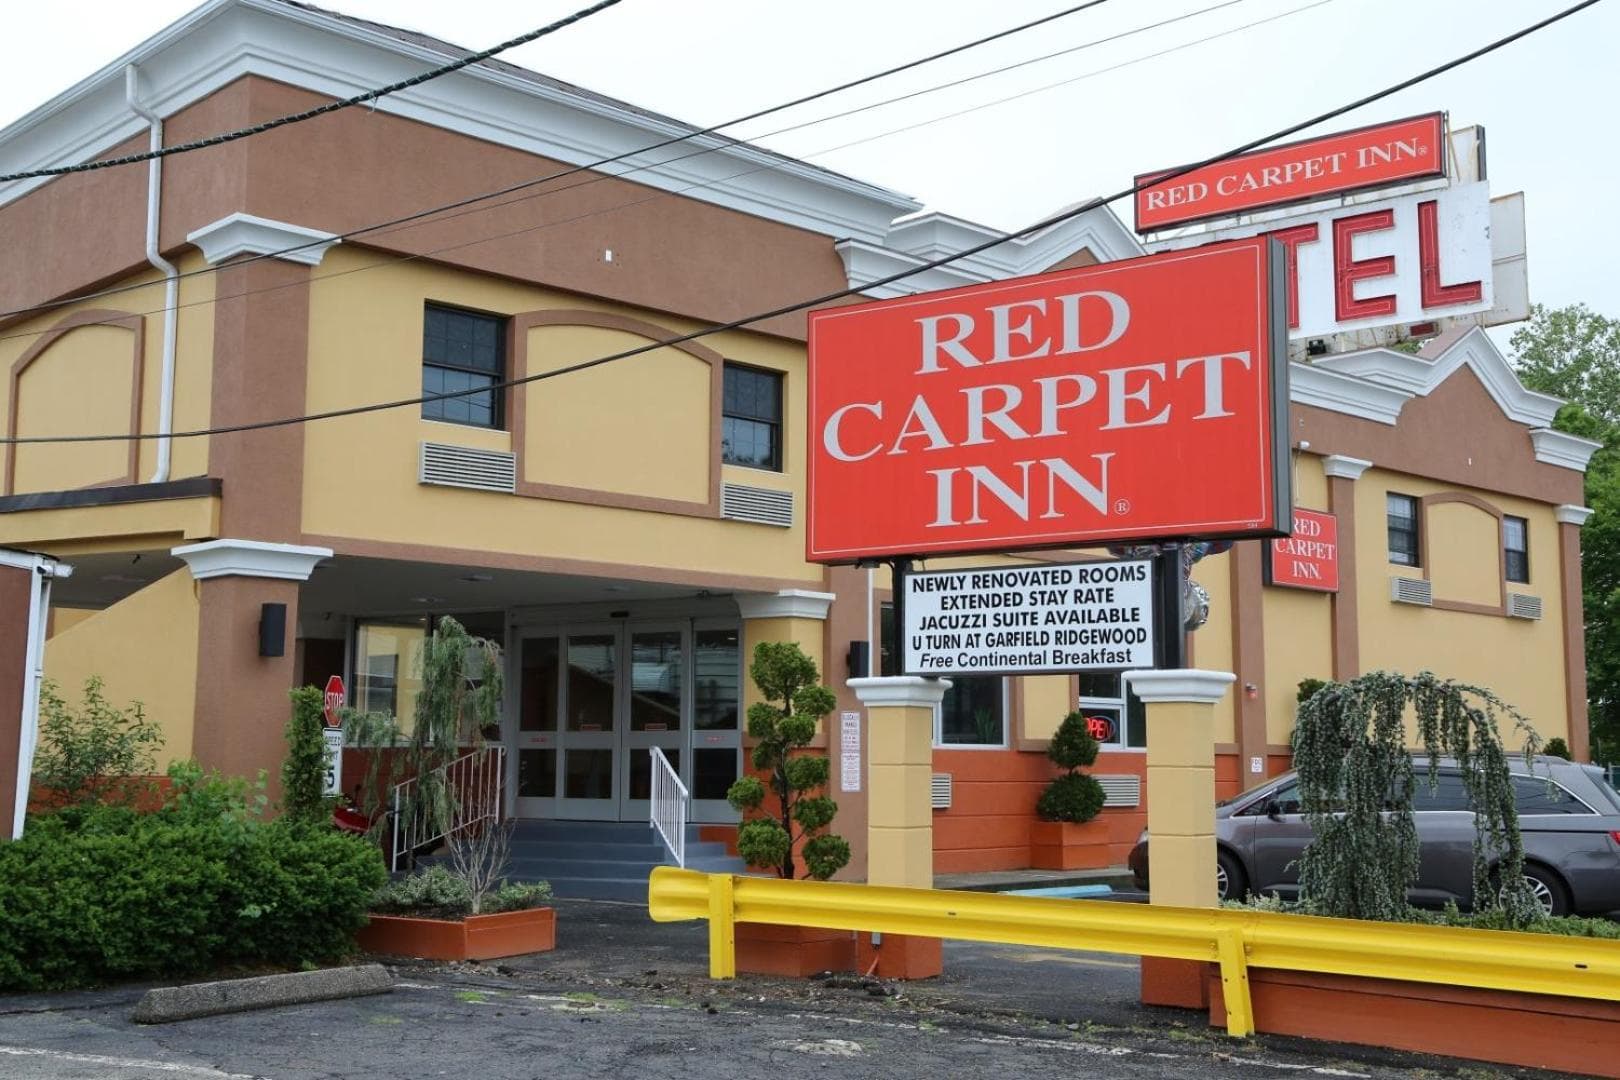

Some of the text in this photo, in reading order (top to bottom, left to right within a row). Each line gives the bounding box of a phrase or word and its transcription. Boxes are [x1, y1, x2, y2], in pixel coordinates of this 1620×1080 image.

[1146, 182, 1208, 210] RED
[1216, 151, 1347, 196] CARPET
[1258, 200, 1483, 328] TEL
[914, 290, 1131, 376] RED
[823, 350, 1251, 462] CARPET
[1275, 538, 1335, 560] CARPET
[912, 565, 1146, 593] NEWLY RENOVATED ROOMS
[941, 587, 1114, 611] EXTENDED STAY RATE
[919, 607, 1140, 630] JACUZZI SUITE AVAILABLE
[912, 628, 1147, 650] U TURN AT GARFIELD RIDGEWOOD
[920, 648, 1132, 668] Free Continental Breakfast
[326, 691, 343, 710] STOP
